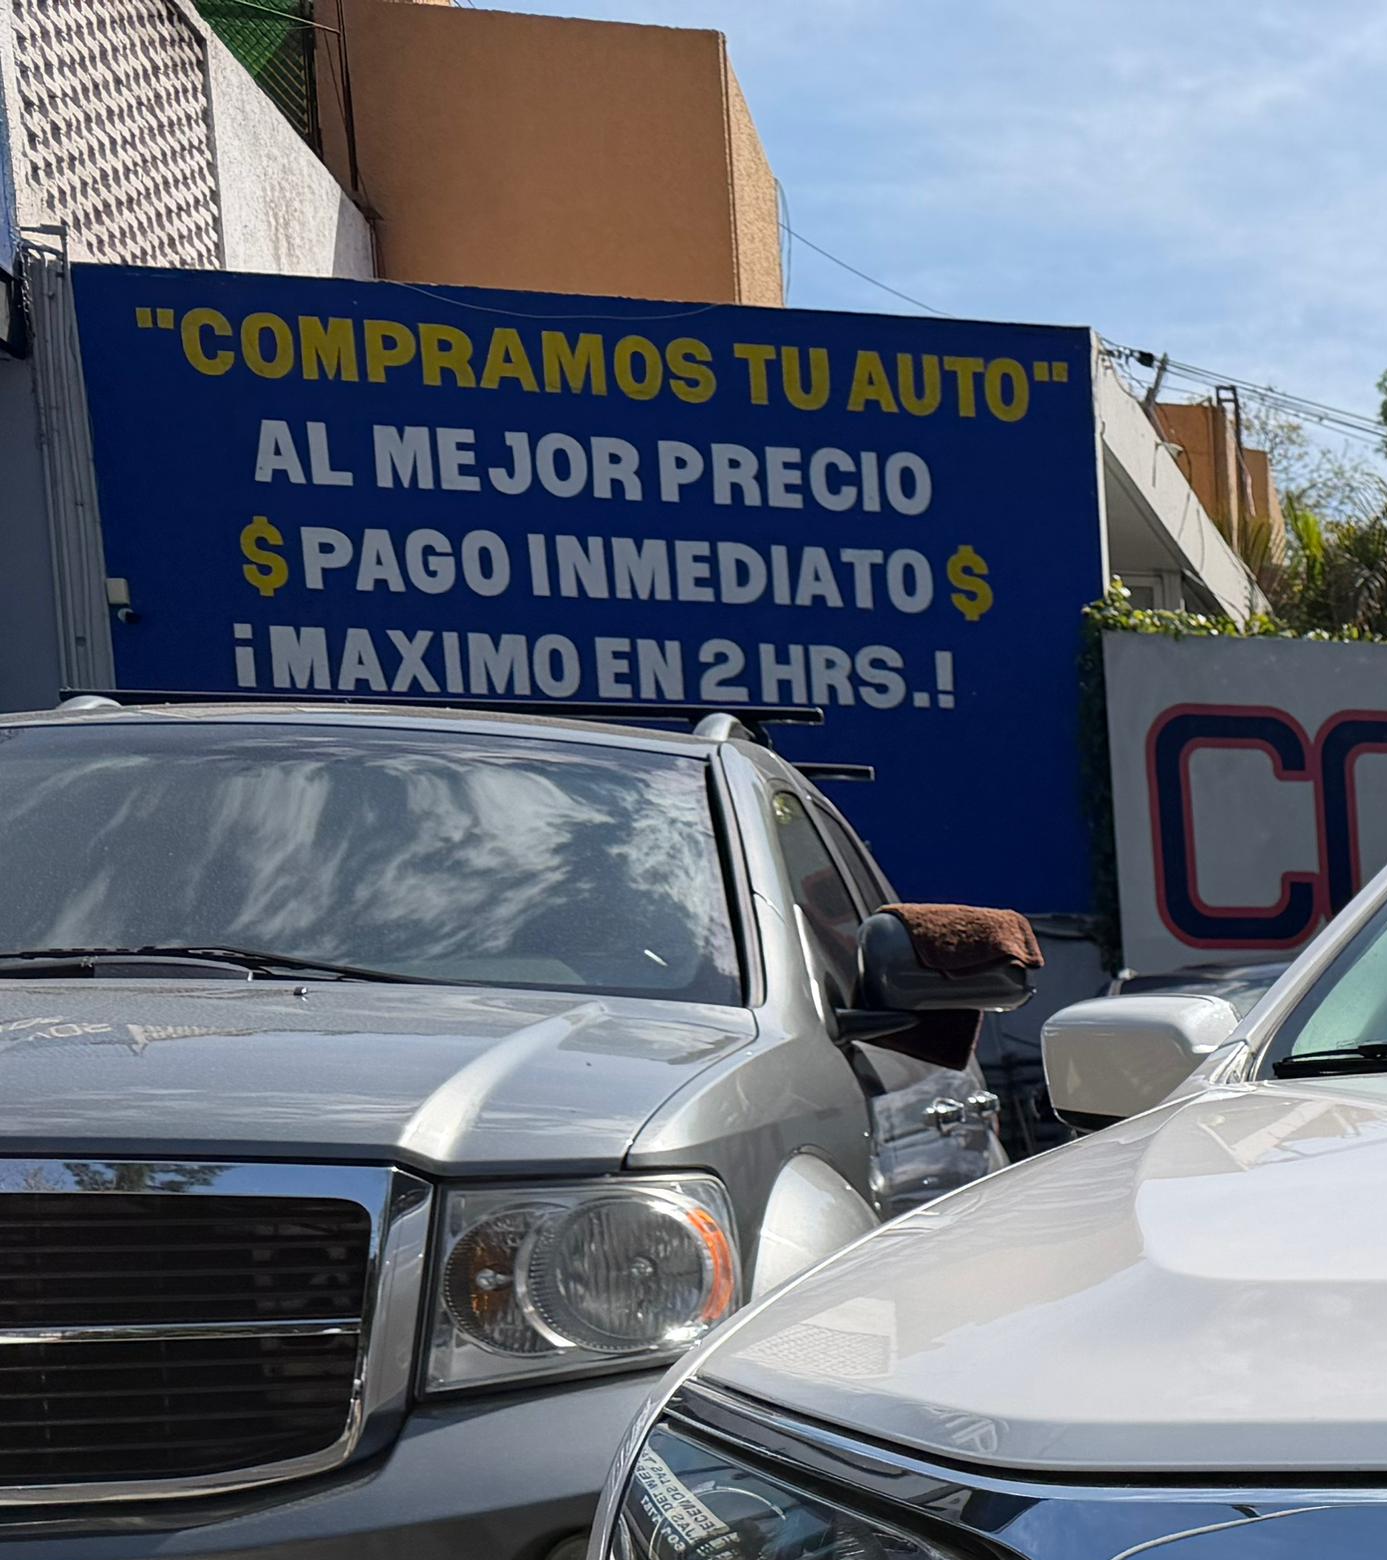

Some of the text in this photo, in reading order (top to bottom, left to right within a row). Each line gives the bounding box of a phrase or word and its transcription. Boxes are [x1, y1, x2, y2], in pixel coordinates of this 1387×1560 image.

[135, 305, 1068, 422] "COMPRAMOS TU AUTO"
[255, 419, 932, 515] AL MEJOR PRECIO
[300, 526, 510, 597] PAGO
[527, 533, 933, 614] INMEDIATO
[595, 637, 685, 700] EN
[698, 639, 750, 703] 2
[759, 643, 956, 710] HRS.!
